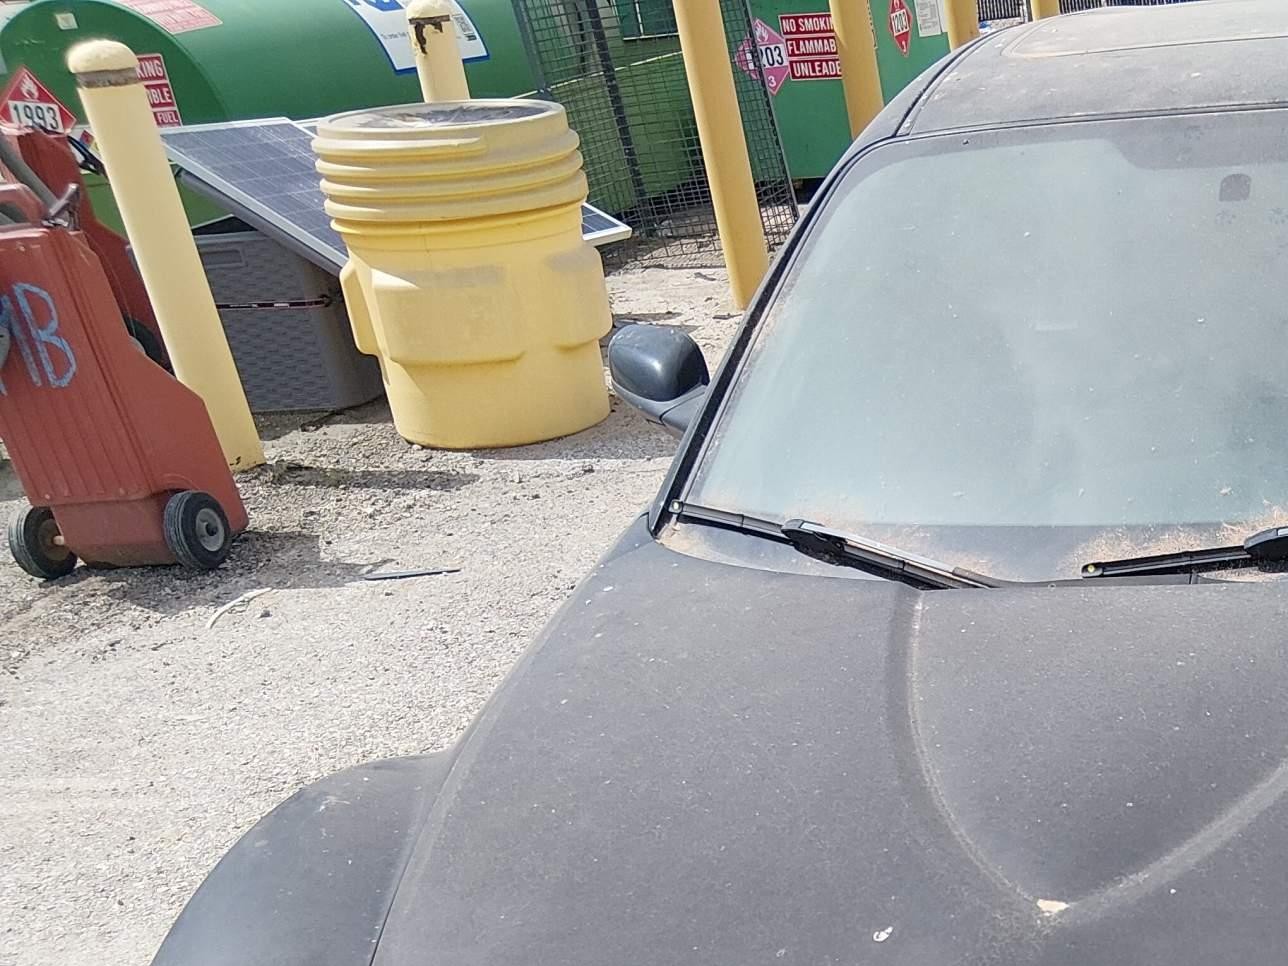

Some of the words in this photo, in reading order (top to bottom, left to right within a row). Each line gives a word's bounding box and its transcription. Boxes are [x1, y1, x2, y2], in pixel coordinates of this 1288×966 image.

[783, 18, 796, 32] NO
[768, 75, 777, 87] 3
[13, 103, 59, 130] 1993
[157, 111, 179, 124] FUEL
